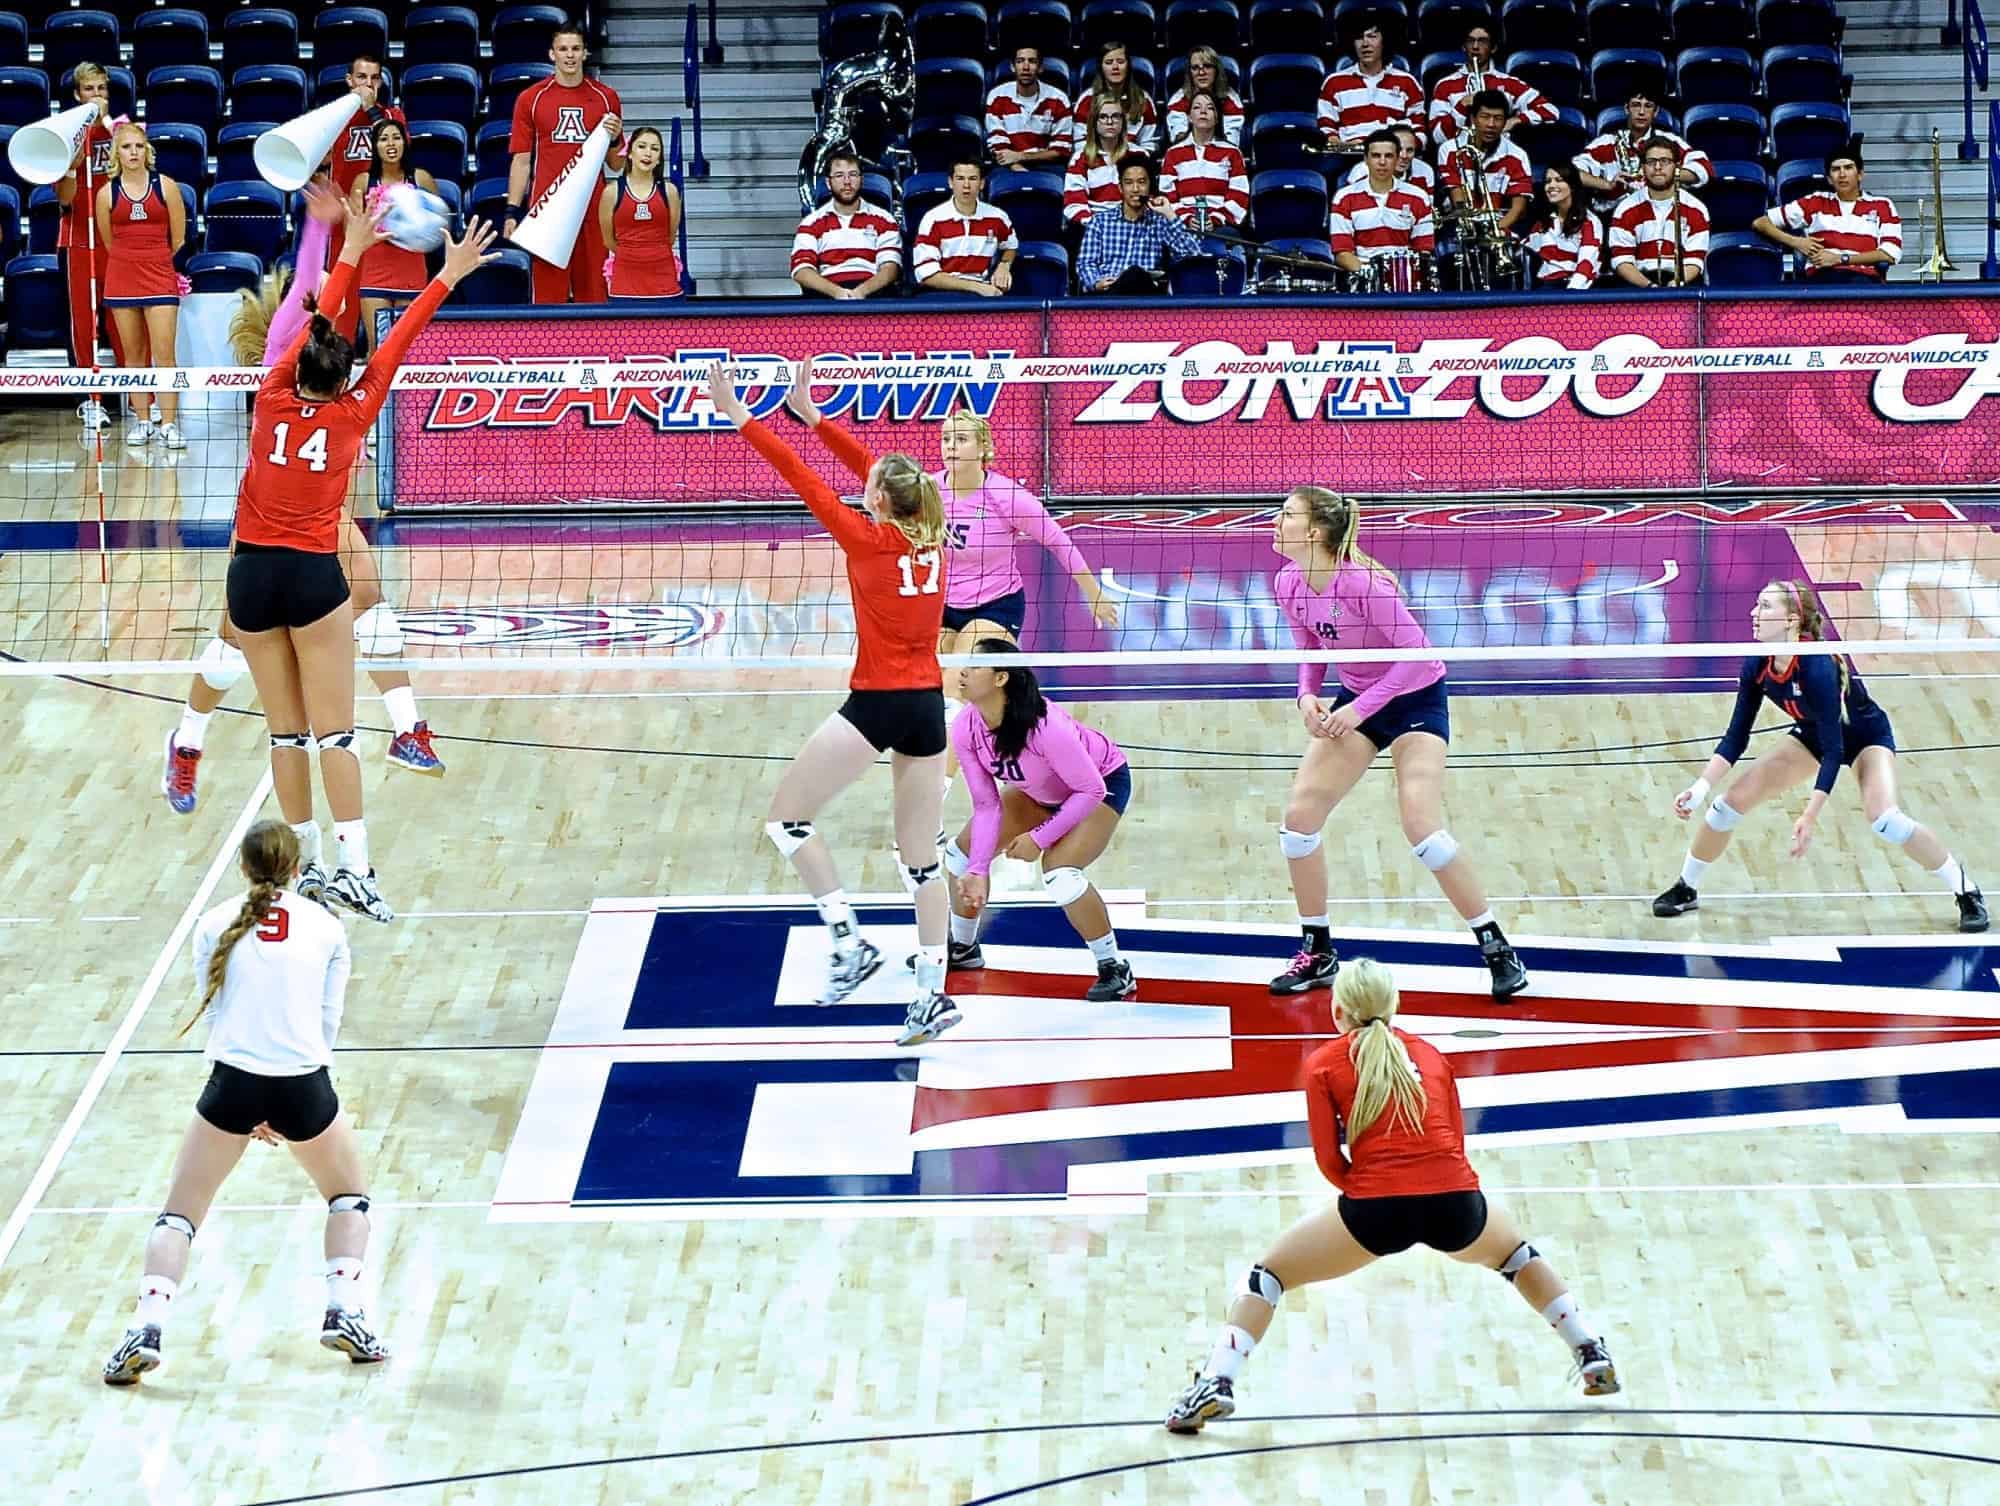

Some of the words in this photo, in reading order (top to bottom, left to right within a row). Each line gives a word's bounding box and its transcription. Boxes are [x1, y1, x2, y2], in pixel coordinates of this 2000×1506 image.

[552, 107, 590, 143] A
[634, 204, 652, 220] A
[0, 374, 159, 387] RIZONAVOLLEYBALL
[205, 374, 265, 386] ARIZON
[399, 370, 566, 384] ARIZONAVOLLEYBALL
[580, 368, 598, 385] A
[774, 366, 791, 382] A
[987, 362, 1005, 379] A
[1020, 362, 1167, 377] ARIZONAWILDCATS
[1182, 360, 1200, 377] A
[1214, 359, 1382, 374] ARIZONAVOLLEYBALL
[1396, 357, 1414, 374] A
[1428, 357, 1576, 372] ARIZONAWILDCATS
[1591, 355, 1608, 371] A
[1624, 353, 1793, 368] ARIZONAVOLLEYBALL
[1840, 350, 1989, 365] ARIZONAWILDCATS
[268, 421, 328, 472] 14
[897, 550, 940, 597] 17
[256, 906, 290, 942] 9
